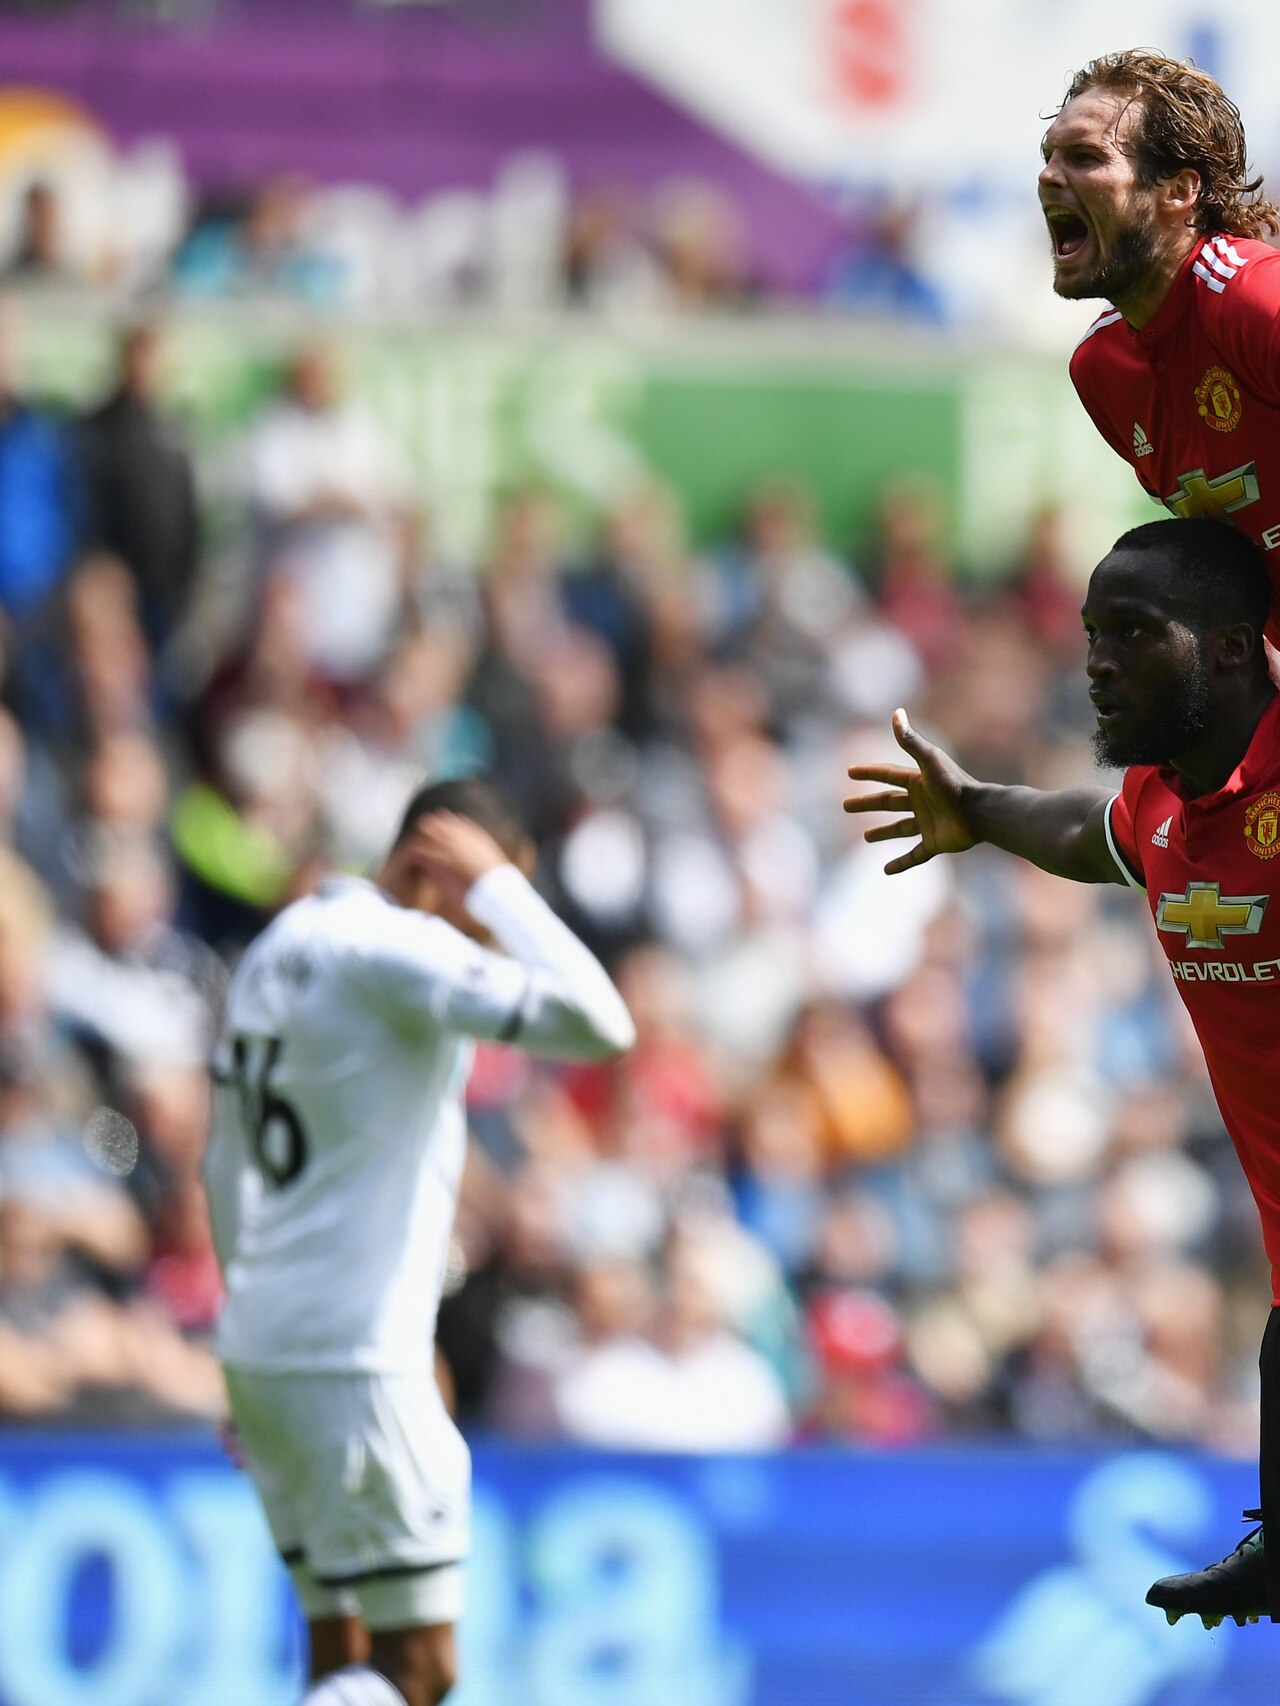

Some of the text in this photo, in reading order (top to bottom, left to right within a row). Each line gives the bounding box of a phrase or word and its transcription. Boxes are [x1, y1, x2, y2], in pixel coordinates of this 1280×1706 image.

[1216, 412, 1239, 428] UNITED
[1135, 443, 1153, 457] adidas
[1151, 834, 1169, 849] adidas
[1253, 842, 1280, 855] UNITED
